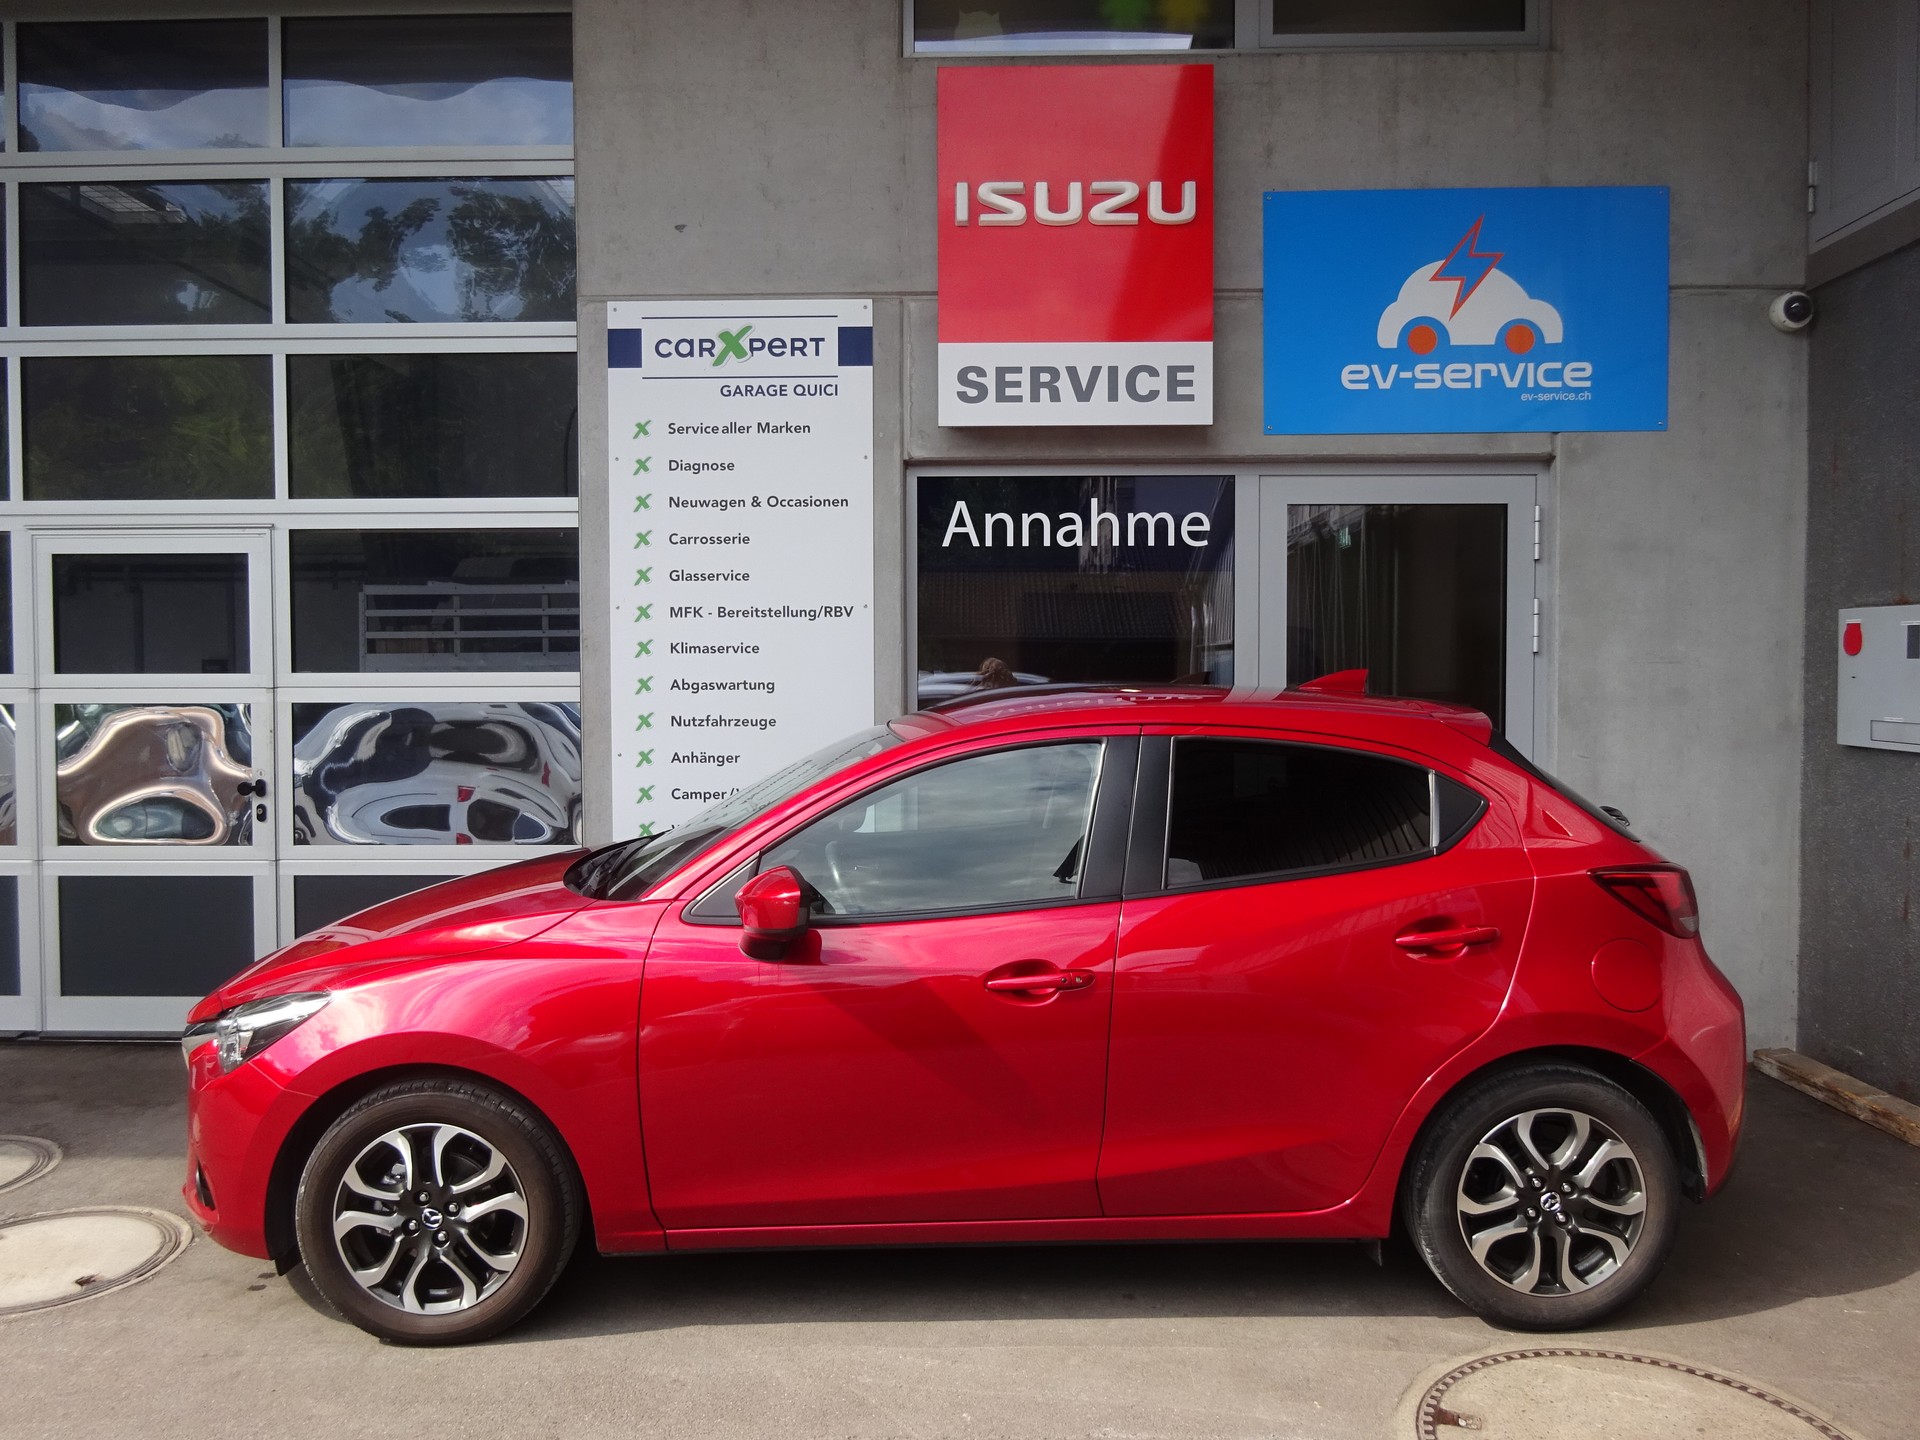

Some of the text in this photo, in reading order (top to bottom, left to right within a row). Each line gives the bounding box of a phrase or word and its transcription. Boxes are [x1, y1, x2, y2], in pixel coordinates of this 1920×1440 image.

[955, 180, 1196, 227] ISUZU
[1341, 361, 1592, 390] ev-service
[719, 383, 839, 398] GARAGE QUICI
[956, 364, 1196, 404] SERVICE
[1520, 391, 1592, 402] ev-service.ch
[757, 420, 811, 434] Marken
[668, 459, 735, 475] Diagnose
[668, 495, 849, 512] Neuwagen & Occasionen
[941, 497, 1211, 548] Annahme
[668, 532, 751, 545] Carrosserie
[668, 569, 750, 582] Glasservice
[669, 606, 704, 619] MFK
[717, 605, 854, 621] Bereitstellung/RBV
[670, 642, 760, 655] Klimaservice
[670, 678, 775, 694] Abgaswartung
[670, 715, 777, 731] Nutzfahrzeuge
[670, 751, 741, 767] Anhänger
[671, 787, 740, 803] Camper/
